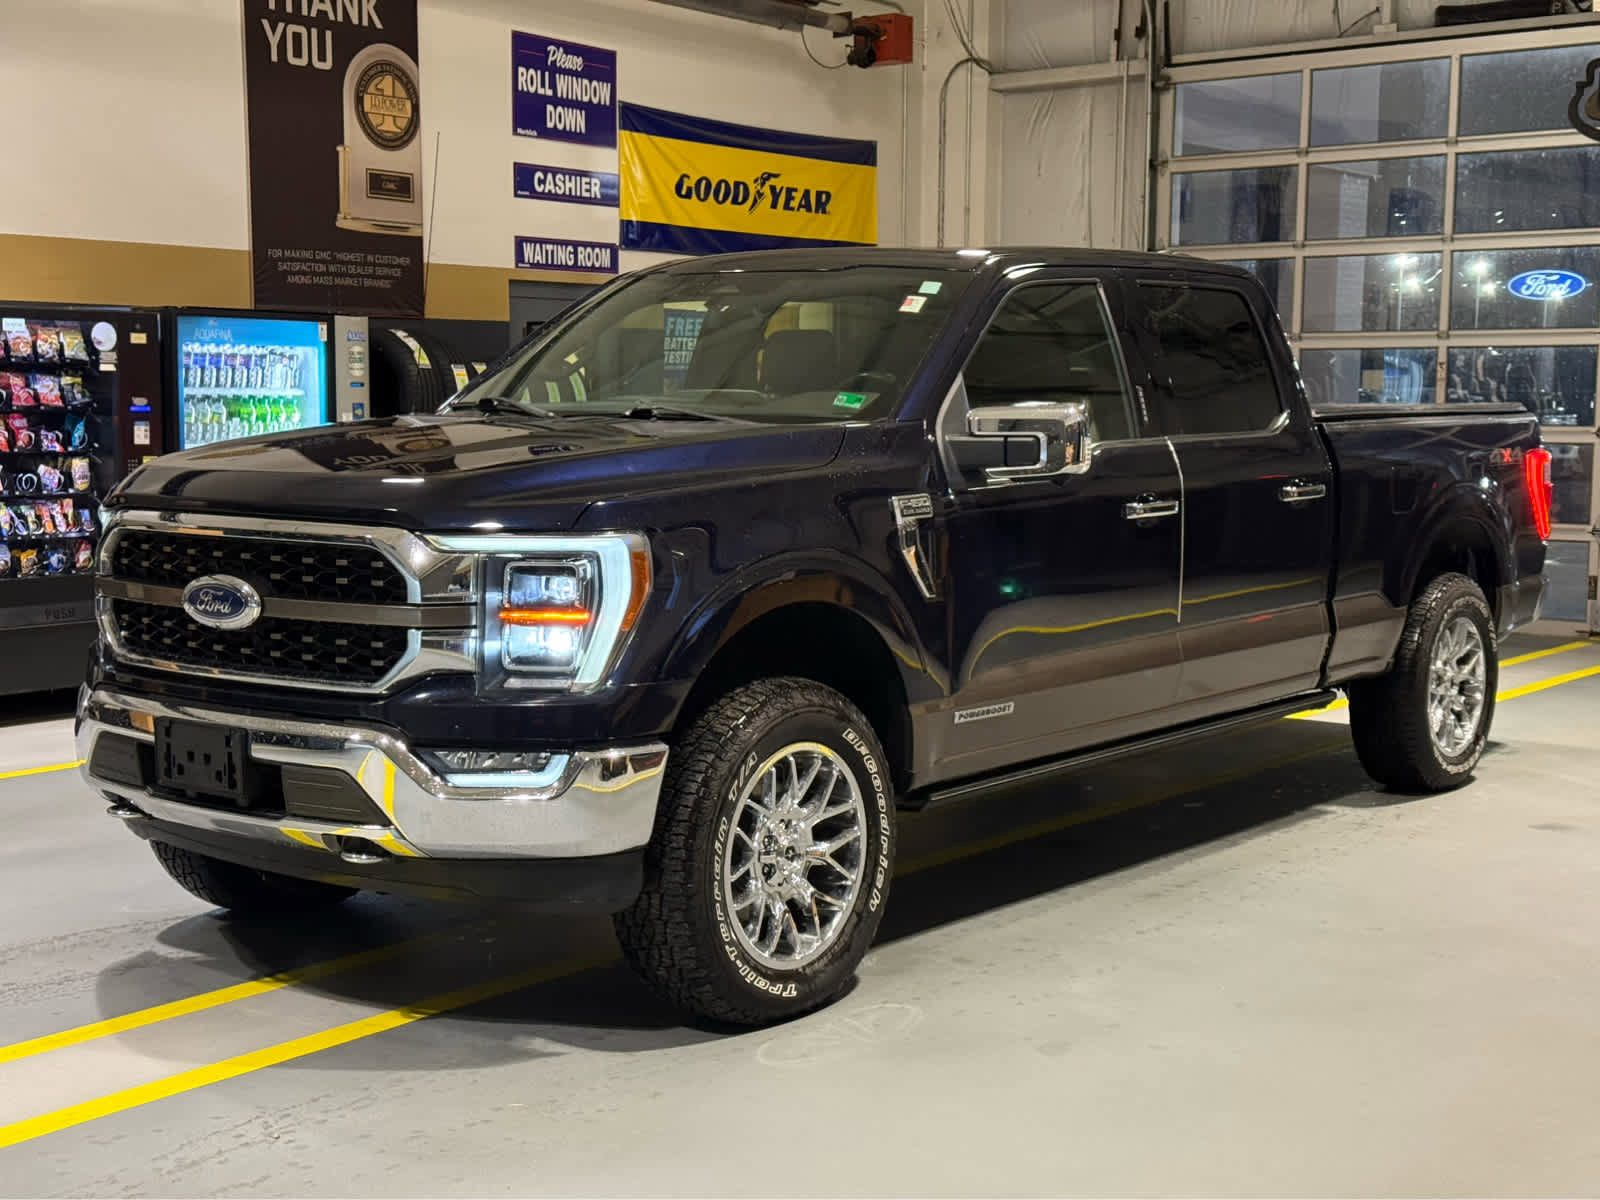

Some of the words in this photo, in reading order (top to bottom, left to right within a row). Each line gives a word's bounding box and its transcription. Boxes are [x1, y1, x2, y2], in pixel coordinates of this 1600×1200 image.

[268, 0, 384, 30] ANK
[261, 18, 333, 71] YOU
[546, 45, 584, 72] Please
[518, 66, 553, 96] ROLL
[555, 73, 612, 106] WINDOW
[546, 104, 586, 134] DOWN
[533, 170, 602, 199] CASHIER
[267, 248, 283, 258] FOR
[284, 249, 314, 259] MAKING
[375, 254, 411, 266] CUSTOMER
[522, 241, 574, 266] WAITING
[577, 246, 611, 269] ROOM
[277, 262, 327, 273] SATISFACTION
[328, 263, 347, 273] WITH
[348, 265, 374, 275] DEALER
[375, 267, 402, 278] SERVICE
[286, 274, 312, 285] AMONG
[313, 276, 333, 286] MASS
[334, 277, 363, 288] MARKET
[1521, 274, 1572, 296] Ford
[196, 588, 233, 614] Ford
[957, 703, 1013, 721] POWERBOOST
[728, 751, 758, 802] T/A
